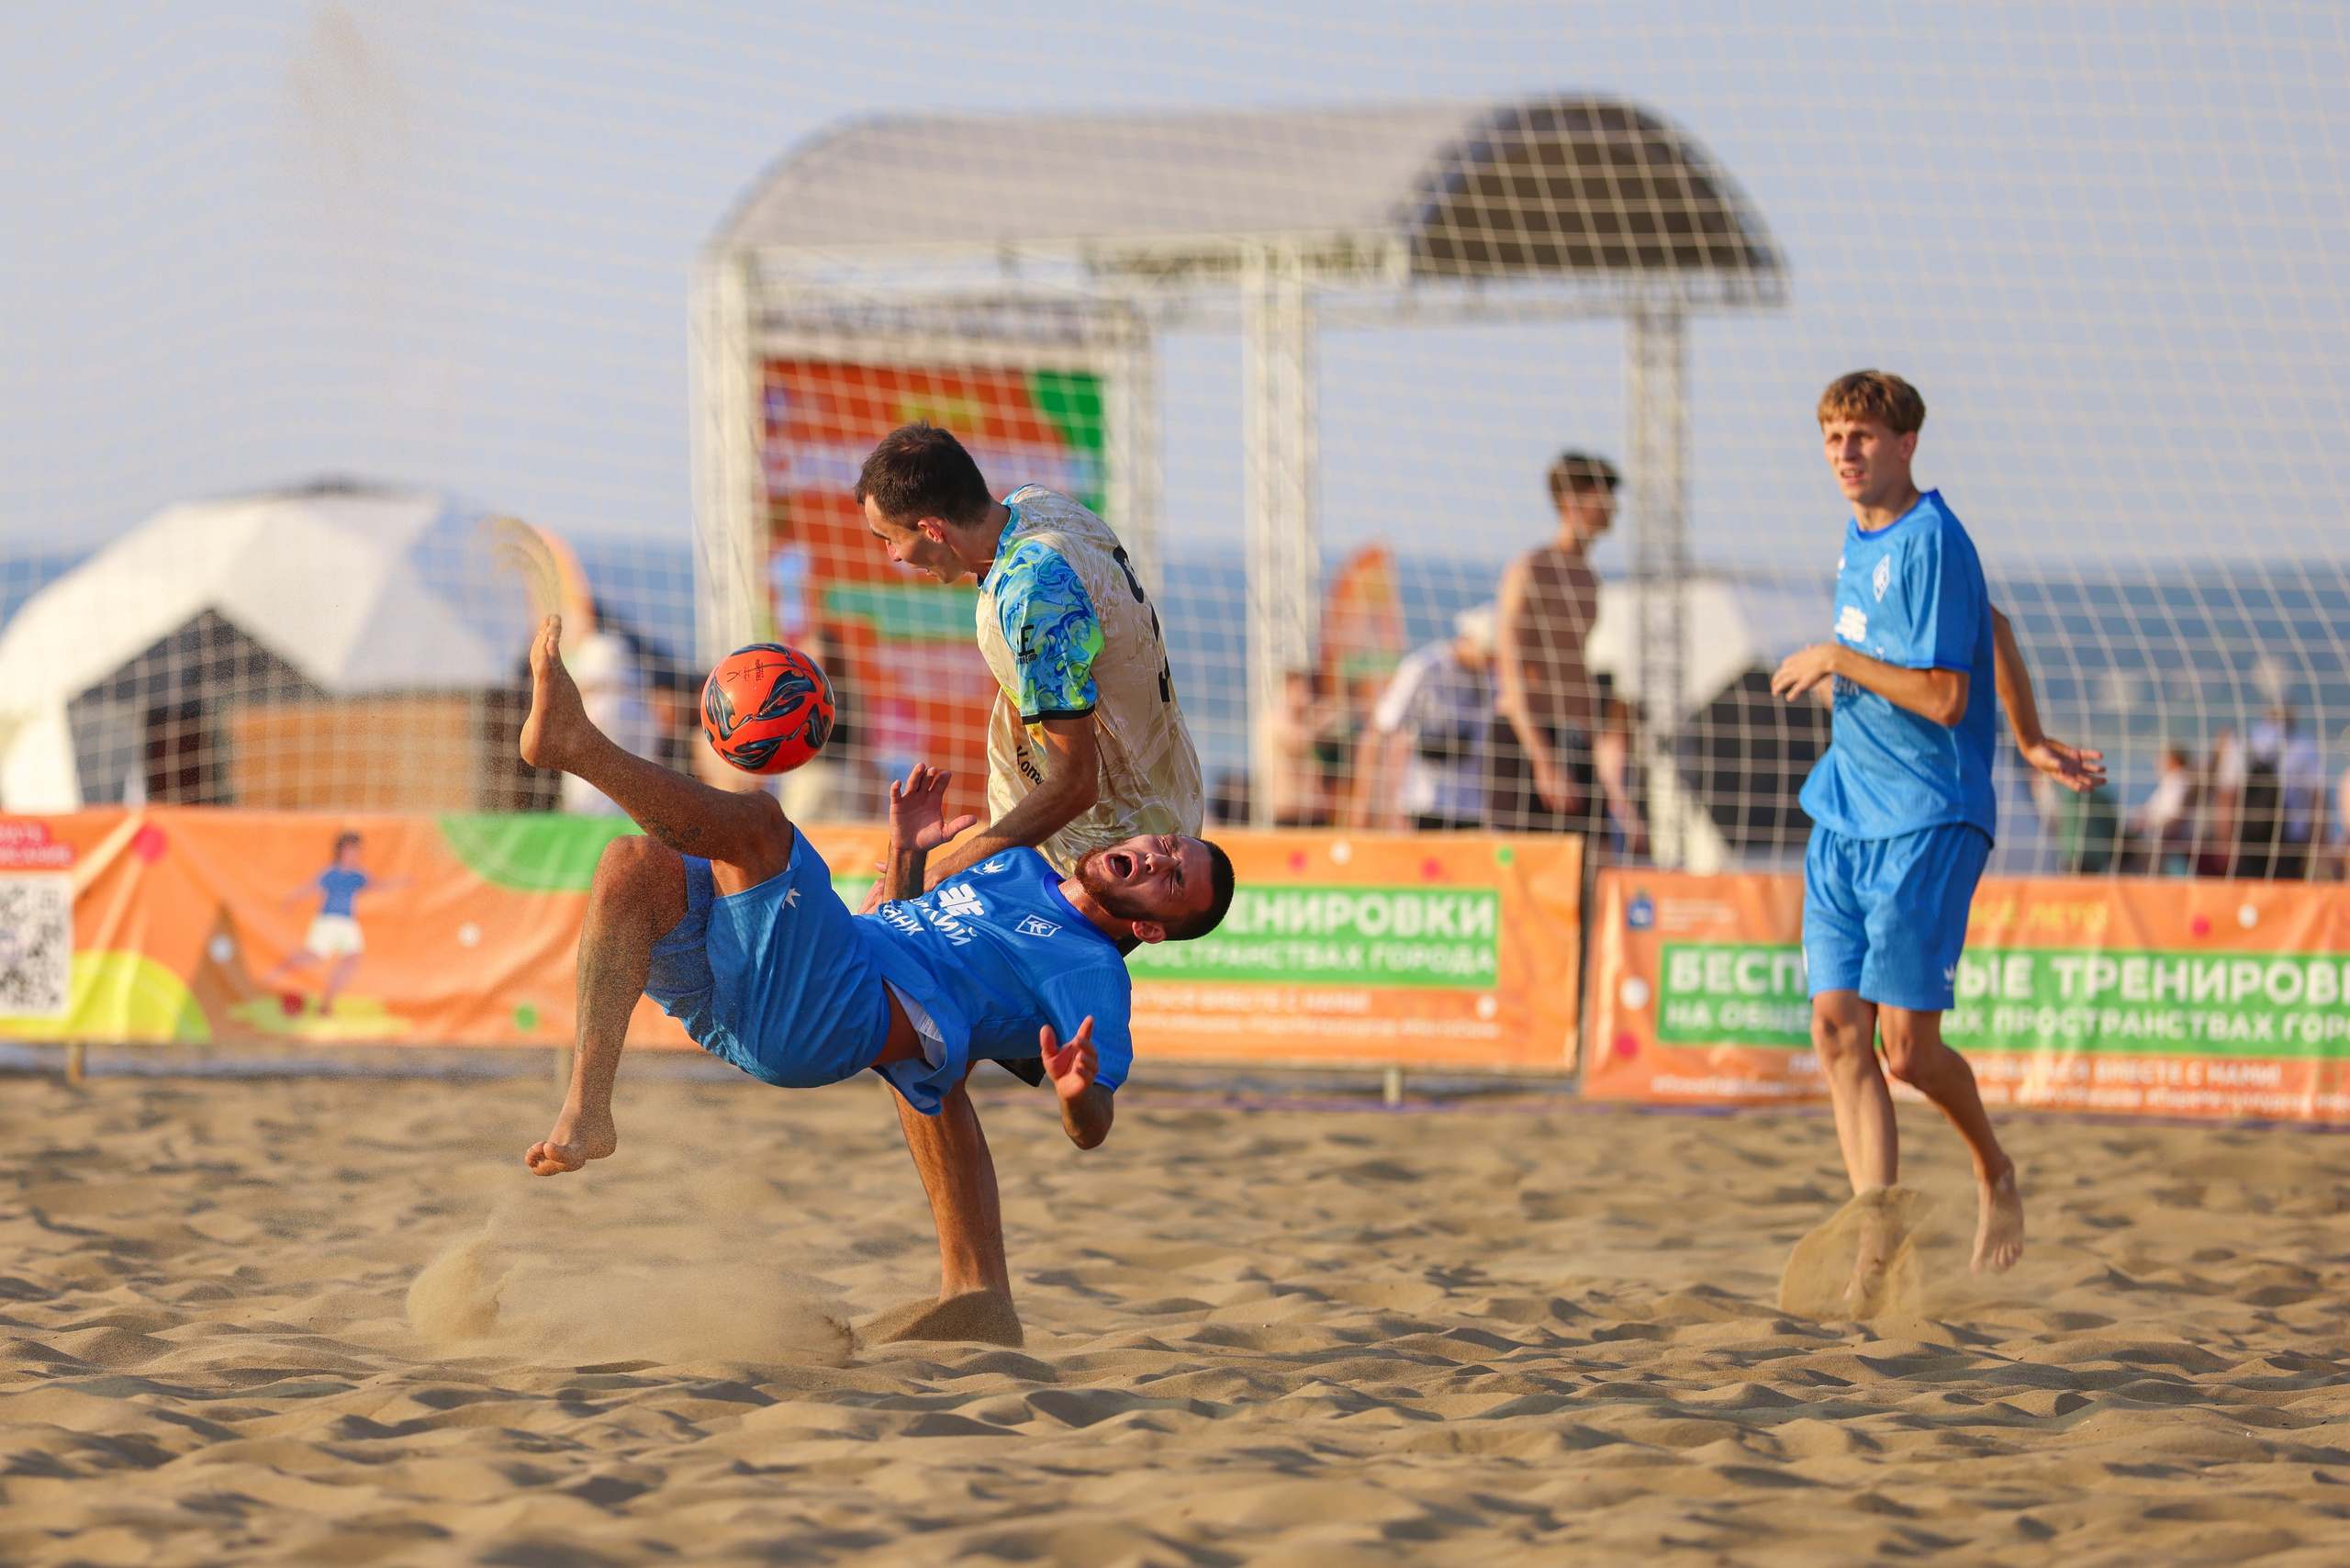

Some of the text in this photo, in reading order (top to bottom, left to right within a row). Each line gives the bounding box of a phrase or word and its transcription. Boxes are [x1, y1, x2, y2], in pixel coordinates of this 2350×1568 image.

[1224, 891, 1494, 939] ЕНИРОВКИ
[1369, 944, 1496, 976] ГОРОДА
[1666, 1000, 1712, 1030] НА
[1992, 1005, 2274, 1042] ПРОСТРАНСТВАХ
[2281, 1012, 2350, 1045] ГОР
